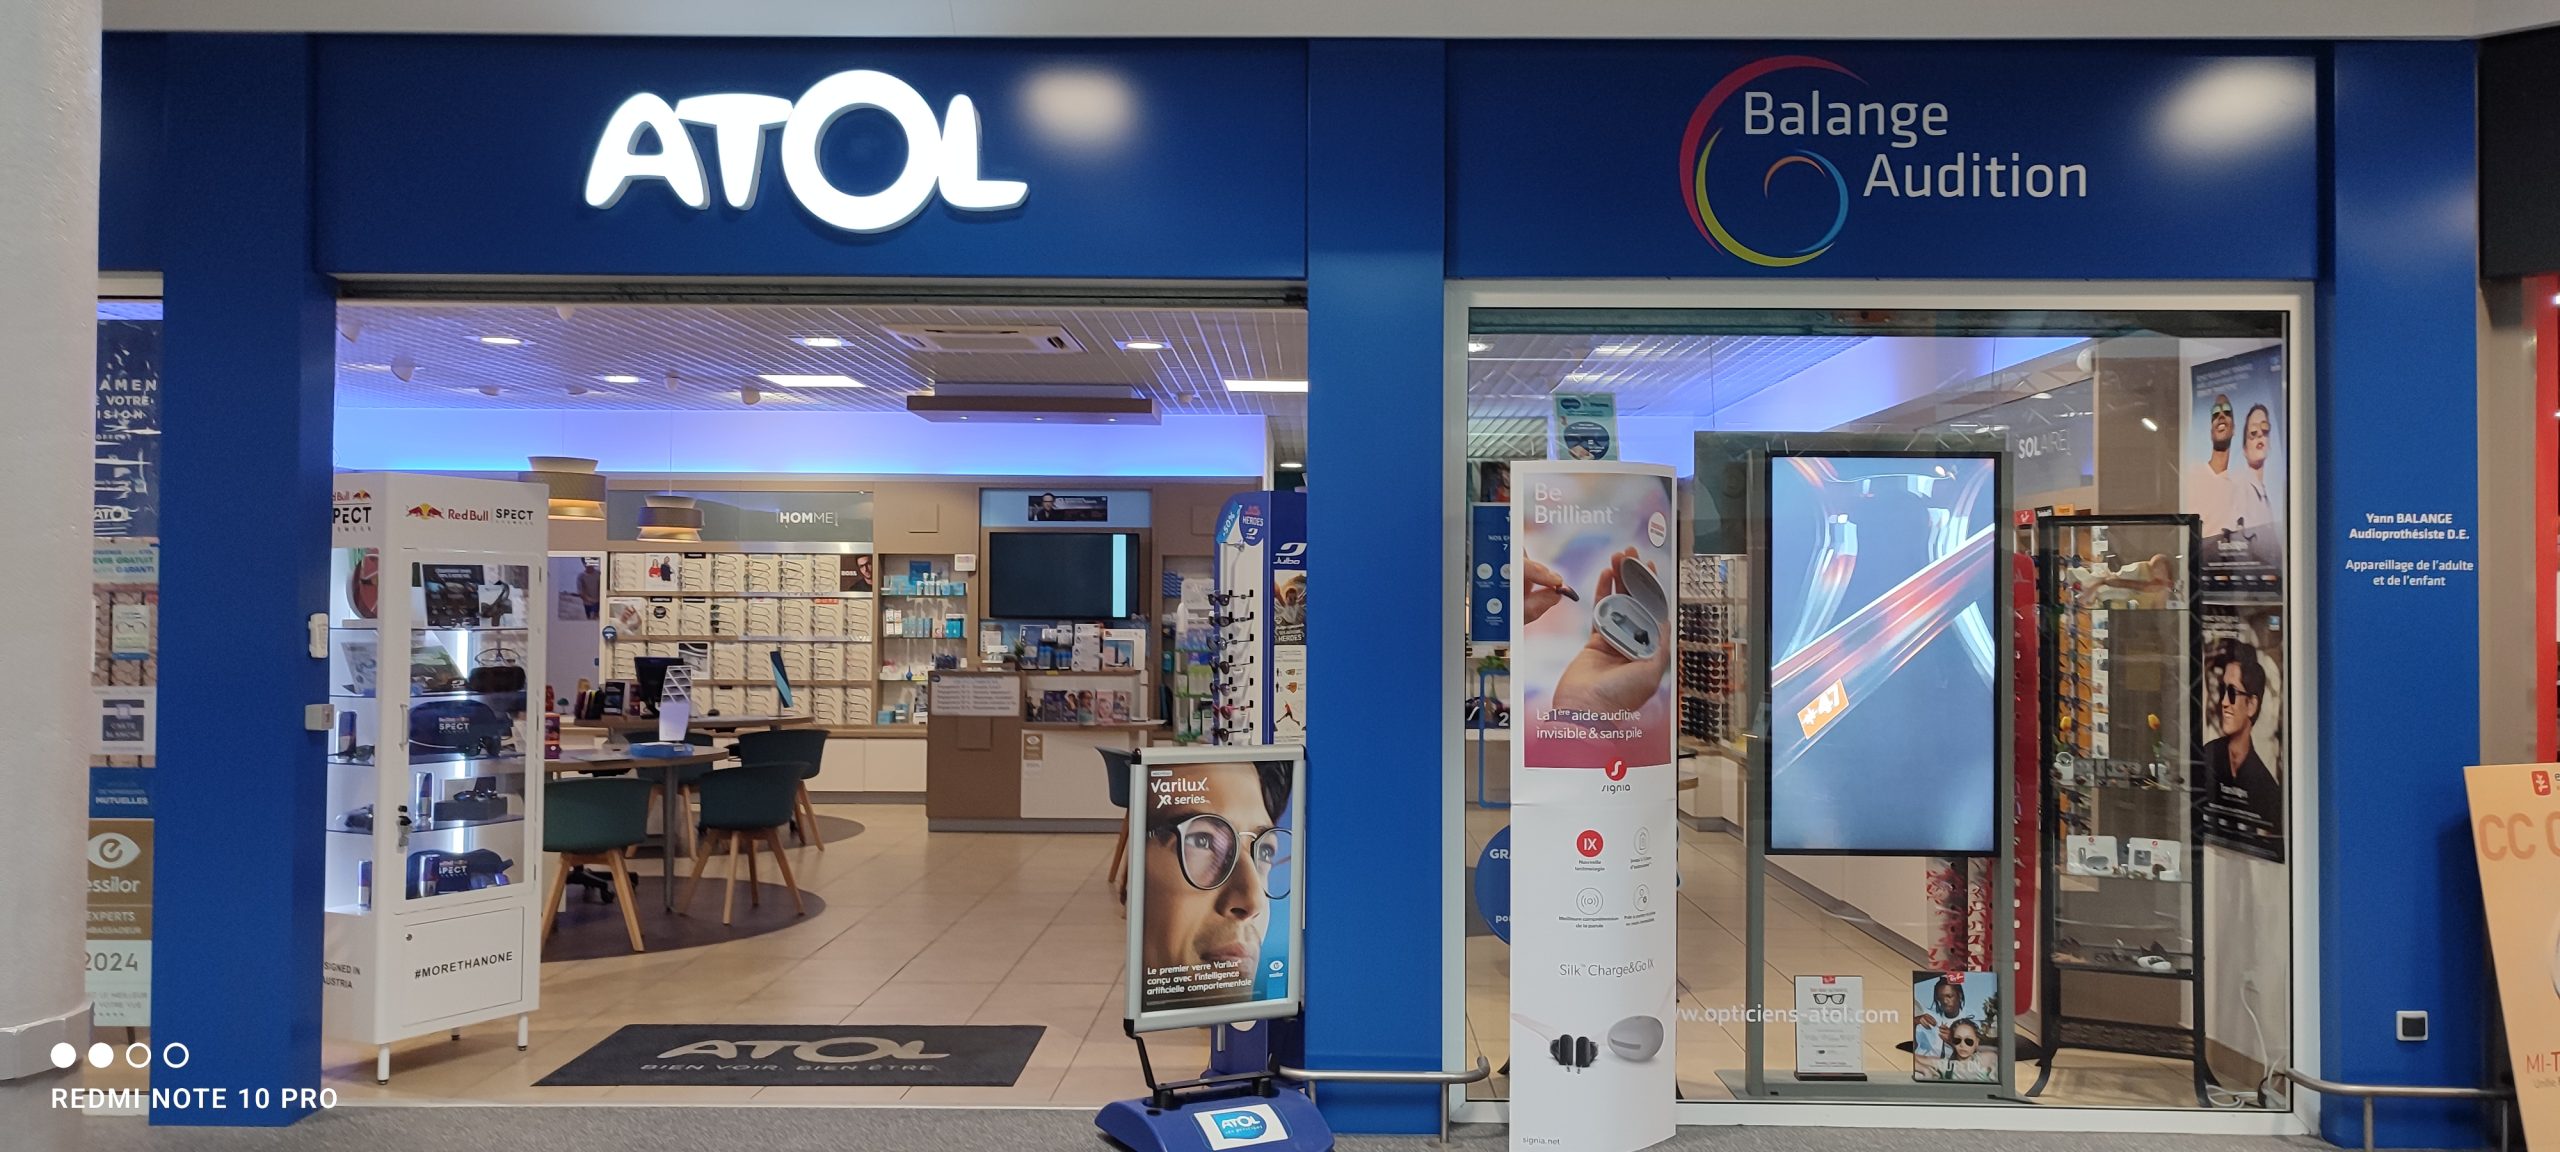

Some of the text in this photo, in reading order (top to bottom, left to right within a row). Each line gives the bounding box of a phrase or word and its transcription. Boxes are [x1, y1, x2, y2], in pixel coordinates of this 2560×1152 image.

[1744, 90, 1949, 148] Balange
[585, 69, 1028, 234] ATOL
[1863, 152, 2087, 197] Audition
[99, 379, 157, 391] AMEN
[106, 395, 149, 406] VOTRE
[97, 410, 143, 419] ISION
[1535, 482, 1562, 501] Be
[332, 506, 372, 524] PECT
[448, 508, 533, 521] Red Bull SPECT
[780, 511, 834, 524] HOMME
[1535, 504, 1614, 525] Brilliant
[2366, 512, 2453, 524] Yann BALANGE
[2349, 528, 2470, 541] Audioprothésiste D.E.
[2345, 559, 2474, 573] Appareillage de l'adulte
[2373, 575, 2446, 586] et de l'enfant
[1536, 709, 1550, 721] La
[1571, 709, 1598, 721] aide
[1600, 708, 1641, 721] auditive
[439, 722, 469, 730] SPECT
[1536, 727, 1643, 741] invisible & sans pile
[1151, 777, 1208, 793] Varilux
[1601, 784, 1631, 795] signia
[1156, 795, 1206, 808] XR series
[1583, 838, 1597, 850] IX
[2479, 813, 2536, 861] CC
[1489, 848, 1511, 860] GR
[87, 911, 136, 921] EXPERTS
[1495, 915, 1511, 924] po
[85, 952, 138, 971] 2024
[324, 961, 352, 974] SIGNED
[415, 951, 513, 979] #MORETHANONE
[1147, 966, 1157, 976] Le
[1159, 965, 1189, 977] premier
[1192, 962, 1212, 972] verre
[1560, 964, 1582, 976] Silk
[1588, 960, 1646, 978] Charge&Go
[1147, 970, 1240, 988] conçu avec l'intelligence
[1147, 978, 1252, 996] artificielle comportementale
[1676, 1005, 1899, 1026] w.opticiens-atol.com
[657, 1036, 950, 1063] ATOL
[1222, 1115, 1260, 1129] ATOL
[1522, 1136, 1560, 1146] signia.net
